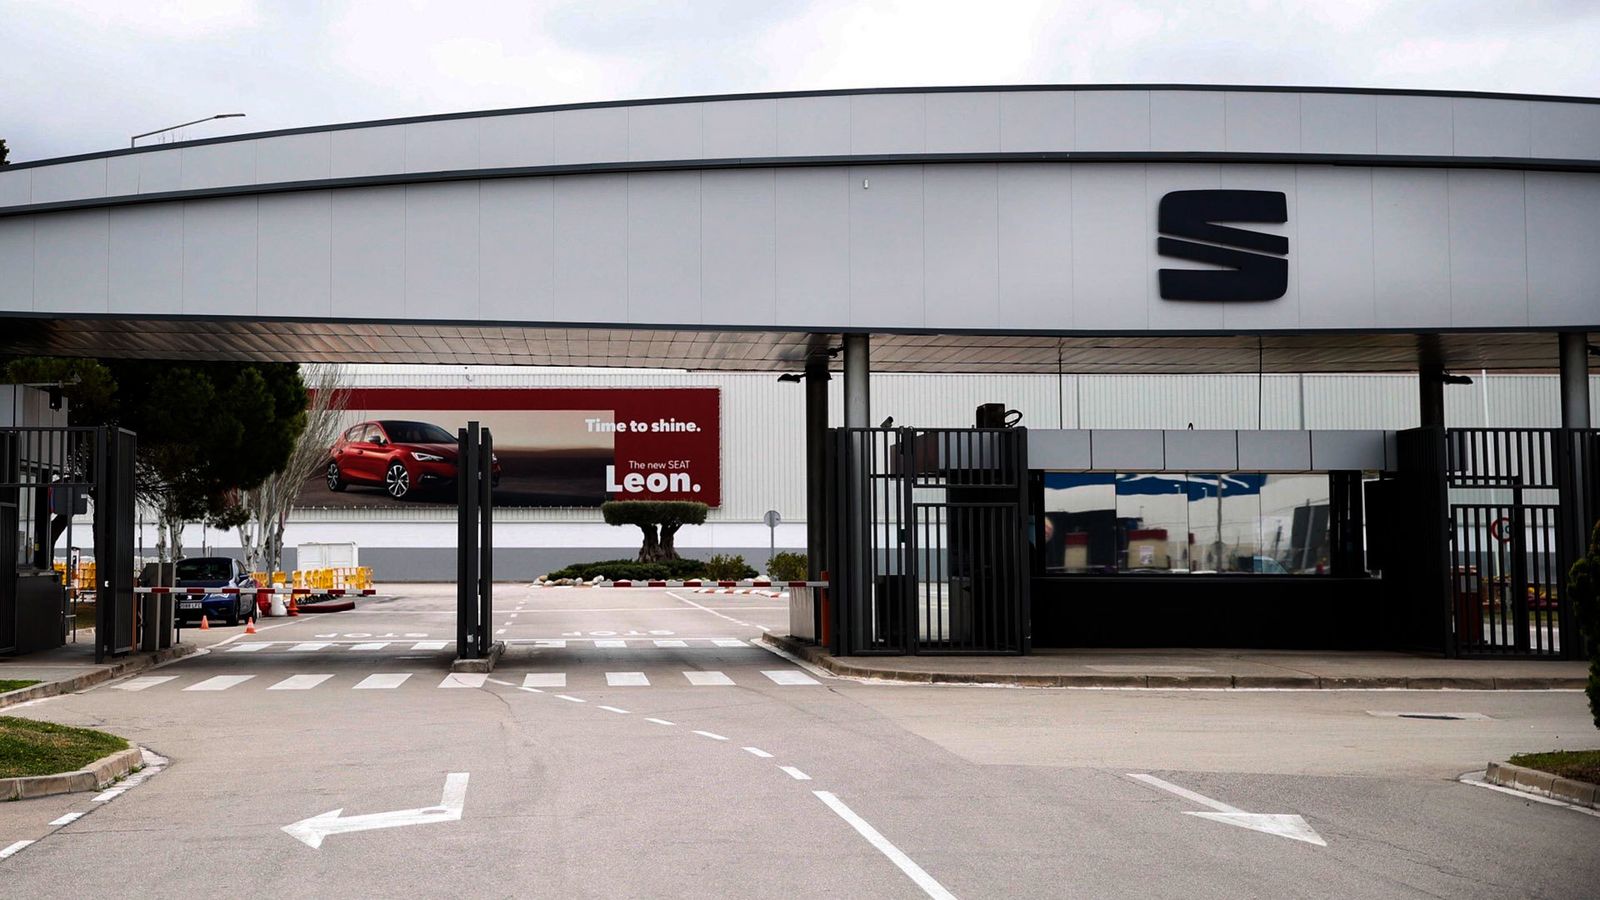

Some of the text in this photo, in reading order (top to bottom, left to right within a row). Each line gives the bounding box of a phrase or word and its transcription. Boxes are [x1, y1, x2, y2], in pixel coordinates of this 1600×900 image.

[1158, 189, 1289, 301] S
[585, 418, 701, 432] Time to shine.
[628, 460, 646, 469] The
[667, 460, 691, 469] SEAT
[606, 465, 701, 493] Leon.
